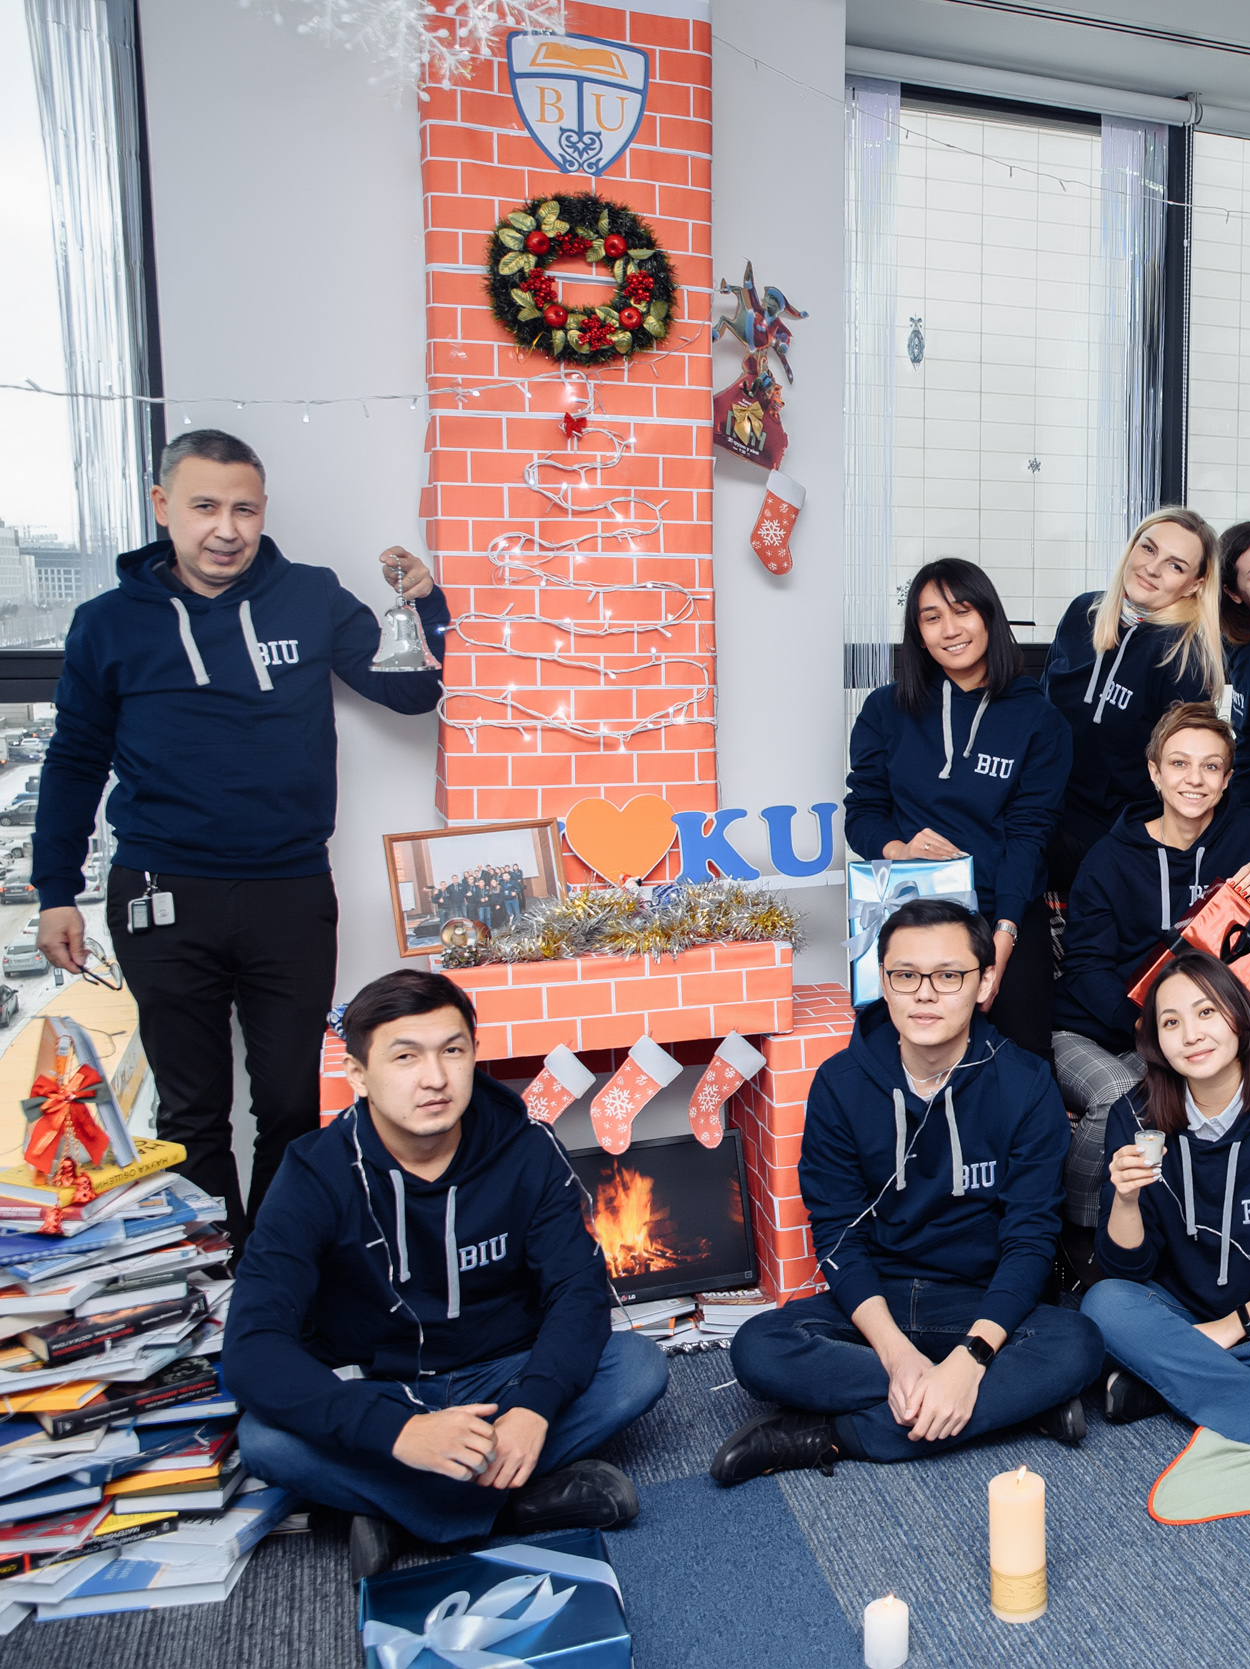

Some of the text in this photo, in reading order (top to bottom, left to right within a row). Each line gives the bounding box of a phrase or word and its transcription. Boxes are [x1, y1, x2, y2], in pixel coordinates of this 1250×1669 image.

[974, 753, 1014, 779] BIU
[671, 802, 838, 885] KU
[93, 1157, 169, 1191] НАУКА ОБЩЕНИ
[459, 1232, 509, 1272] BIU
